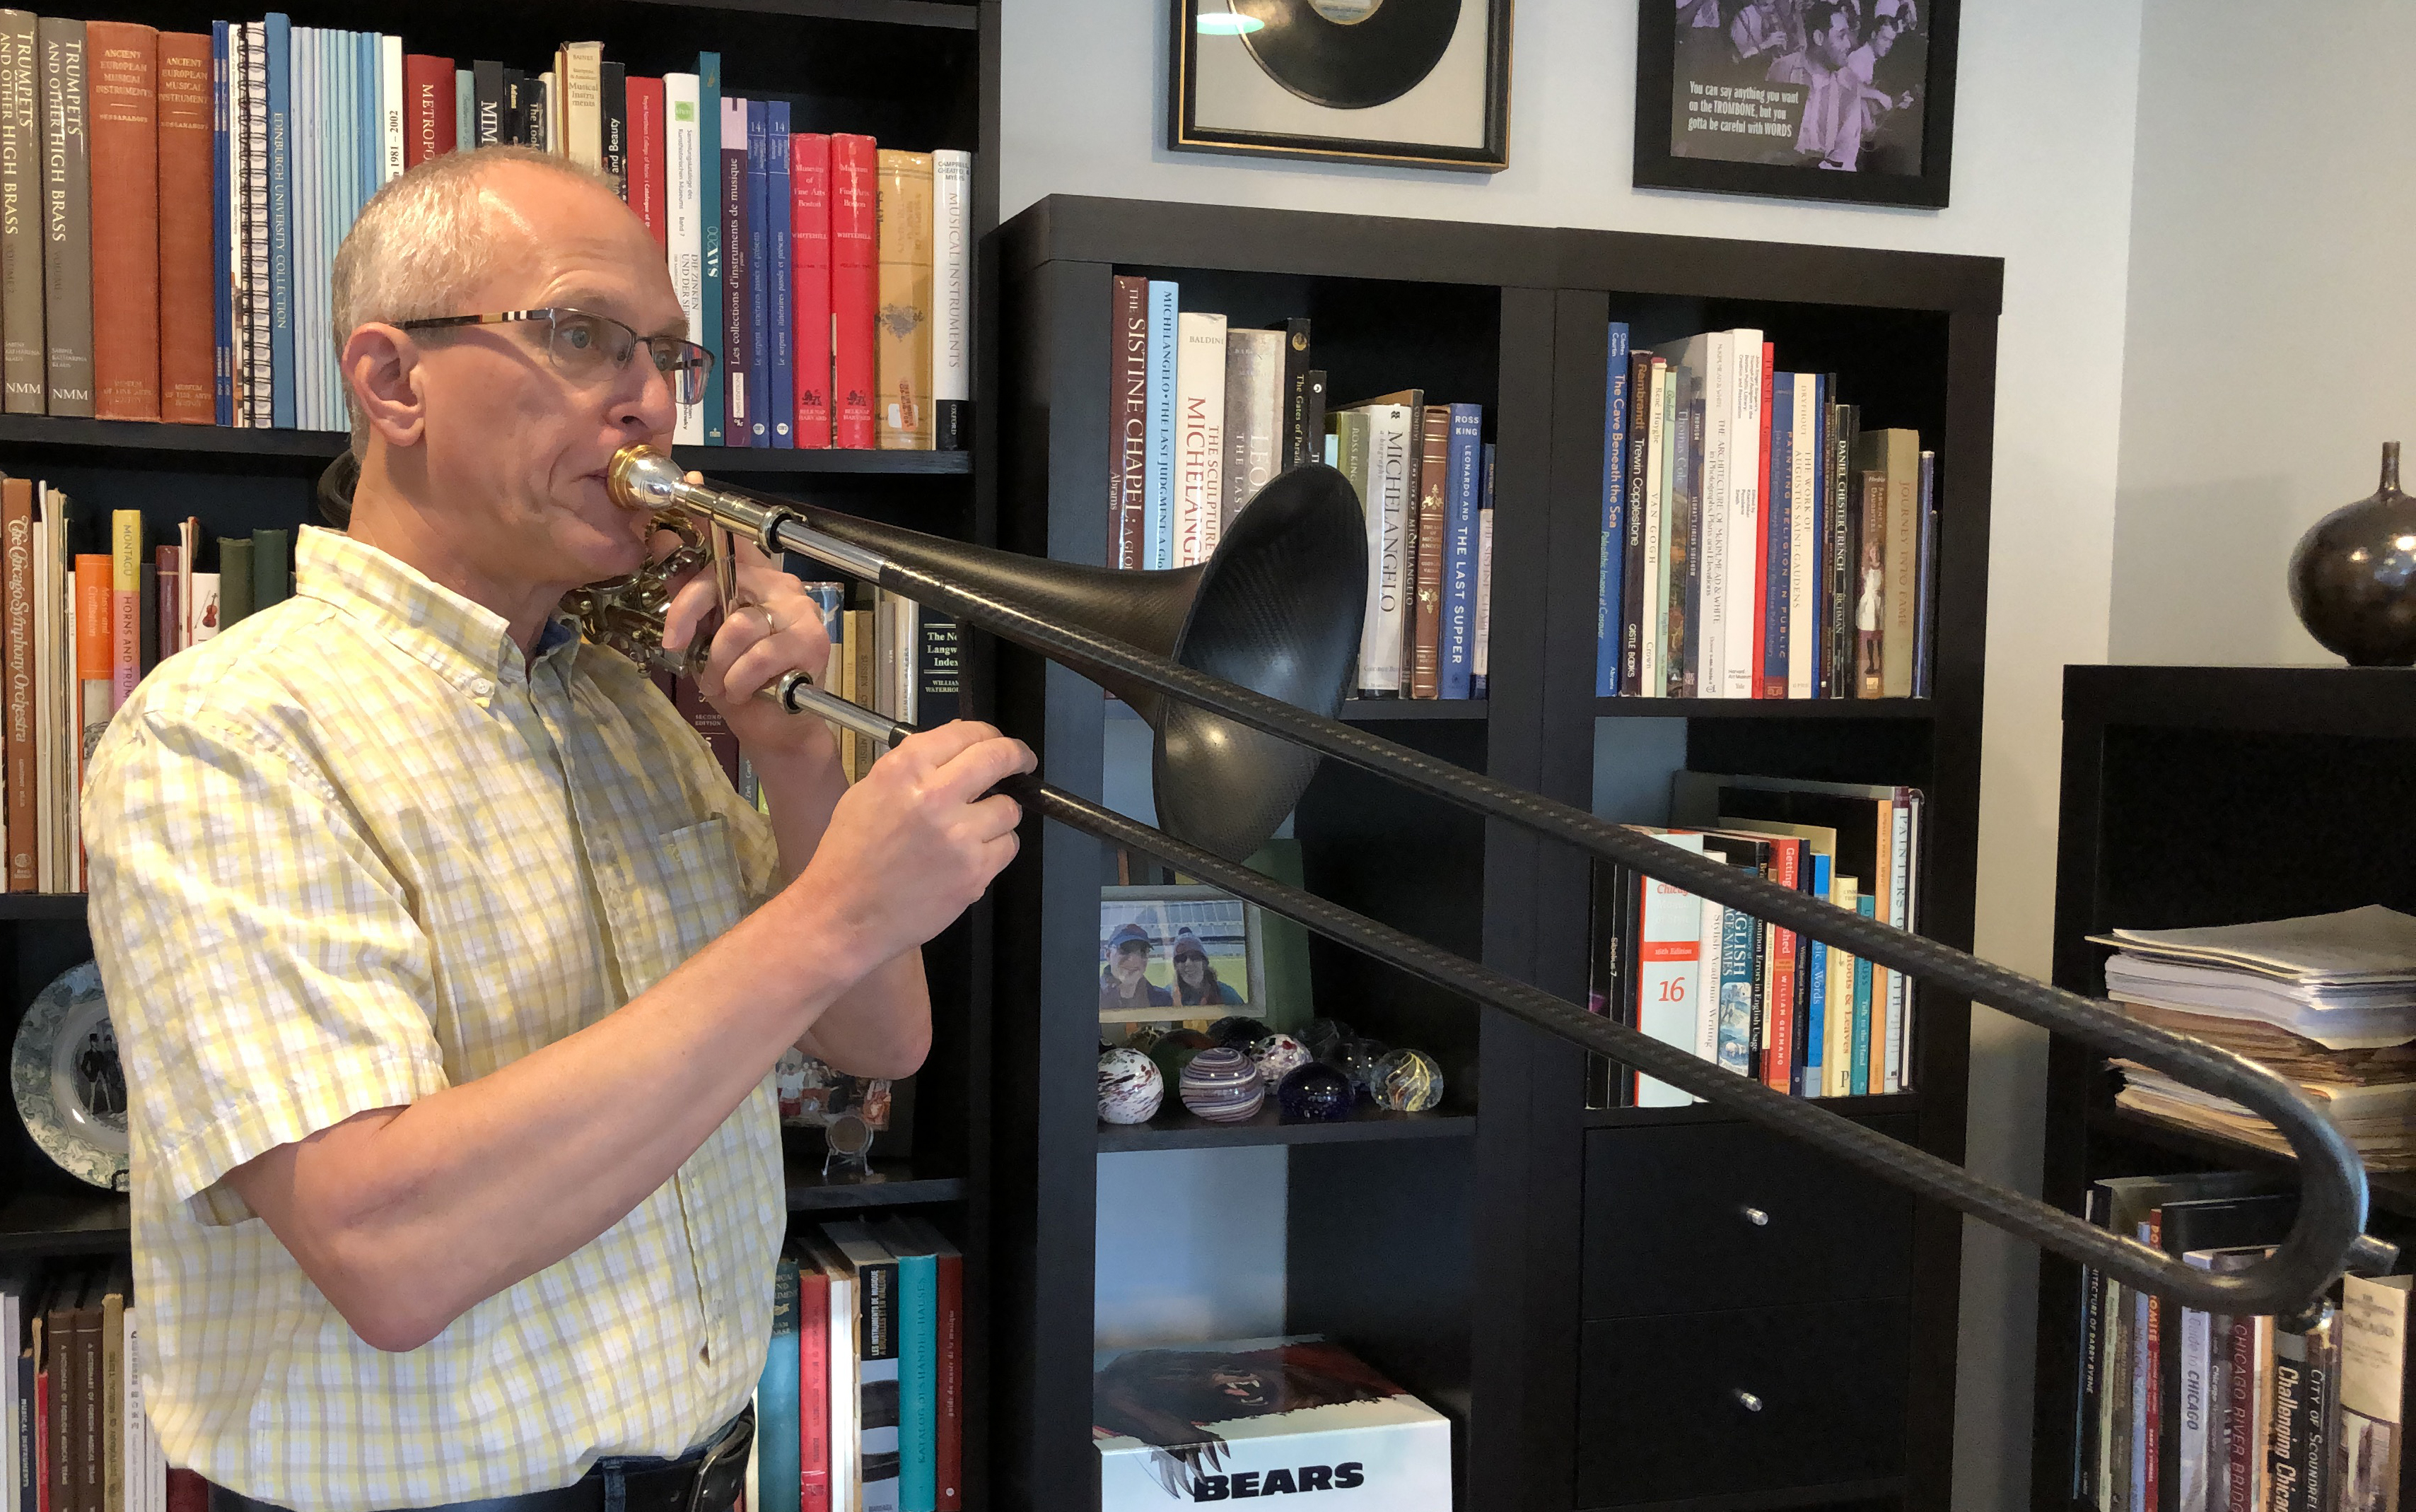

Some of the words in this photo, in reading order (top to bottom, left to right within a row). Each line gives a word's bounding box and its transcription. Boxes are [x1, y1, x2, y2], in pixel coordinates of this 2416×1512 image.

[0, 33, 11, 65] AND
[49, 40, 59, 74] AND
[100, 61, 148, 72] EUROPEAN
[104, 49, 142, 59] ANCIENT
[166, 57, 203, 68] ANCIENT
[18, 33, 33, 128] TRUMPETS
[66, 40, 81, 136] TRUMPETS
[103, 73, 141, 84] MUSICAL
[161, 69, 209, 81] EUROPEAN
[568, 81, 599, 93] Musical
[1690, 81, 1703, 95] You
[1705, 83, 1718, 98] can
[1720, 86, 1732, 100] say
[1734, 86, 1766, 104] anything
[1766, 90, 1780, 103] you
[1781, 91, 1799, 104] want
[1, 71, 13, 120] OTHER
[49, 78, 62, 128] OTHER
[530, 102, 539, 122] The
[571, 90, 595, 100] Instru
[571, 99, 596, 108] ments
[1688, 102, 1698, 112] on
[1700, 100, 1712, 114] the
[1713, 100, 1758, 118] TROMBONE,
[1759, 106, 1771, 119] but
[1773, 109, 1787, 122] you
[388, 110, 399, 134] 2002
[481, 100, 498, 145] MIM
[609, 117, 621, 152] Beauty
[751, 122, 761, 132] 14
[774, 121, 785, 132] 14
[1688, 117, 1708, 131] gotta
[1709, 118, 1719, 130] be
[1720, 119, 1746, 133] careful
[1747, 121, 1763, 135] with
[1763, 122, 1793, 138] WORDS
[2, 125, 17, 175] HIGH
[50, 133, 65, 182] HIGH
[274, 112, 284, 183] EDINBURGH
[390, 146, 399, 168] 1981
[612, 156, 620, 174] and
[4, 182, 18, 235] BRASS
[51, 190, 66, 242] BRASS
[274, 184, 286, 252] UNIVERSITY
[798, 199, 822, 208] Boston
[949, 192, 960, 255] MUSICAL
[275, 254, 286, 329] COLLECTION
[691, 272, 699, 310] ZINKEN
[1129, 287, 1139, 314] THE
[949, 263, 960, 368] INSTRUMENTS
[1127, 317, 1145, 413] SISTINE
[6, 382, 41, 394] NMM
[52, 388, 88, 401] NMM
[1297, 374, 1305, 393] The
[1614, 373, 1626, 396] The
[1635, 363, 1647, 430] Rembrandt
[1295, 396, 1304, 421] Gates
[1454, 416, 1480, 424] ROSS
[1613, 397, 1625, 431] Cave
[1208, 425, 1220, 456] THE
[1295, 424, 1303, 436] of
[1455, 427, 1478, 436] KING
[1651, 411, 1662, 445] Huyghe
[1677, 408, 1688, 455] Thomas
[1124, 418, 1144, 523] CHAPEL:
[1463, 445, 1472, 498] LEONARDO
[1611, 432, 1623, 483] Beneath
[1633, 438, 1645, 475] Trewin
[1676, 456, 1688, 484] Cole
[1785, 430, 1794, 500] PAINTING
[1838, 440, 1847, 479] DANIEL
[1109, 471, 1121, 511] Abrams
[1610, 482, 1622, 503] the
[1717, 440, 1725, 510] ARCHITECTURE
[1794, 450, 1802, 511] AUGUSTUS
[1204, 459, 1218, 551] SCULPTURE
[1380, 430, 1404, 613] MICHELANGELO
[1609, 505, 1621, 529] Sea
[1630, 477, 1644, 547] Copplestone
[1650, 493, 1659, 517] VAN
[1837, 481, 1846, 527] CHESTER
[8, 515, 30, 546] The
[1457, 527, 1468, 556] THE
[1781, 507, 1791, 577] RELIGION
[1803, 516, 1811, 533] OF
[123, 524, 133, 577] MONTAGU
[1649, 524, 1657, 564] GOGH
[1793, 513, 1802, 609] SAINT-GAUDENS
[1836, 529, 1845, 572] FRENCH
[8, 546, 28, 600] Chicago
[1454, 561, 1466, 599] LAST
[1712, 595, 1721, 624] WHITE
[1780, 584, 1788, 599] IN
[123, 596, 133, 635] HORNS
[1778, 606, 1787, 659] PUBLIC
[9, 599, 30, 674] Symphony
[123, 638, 133, 664] AND
[927, 632, 945, 641] The
[1452, 605, 1464, 664] SUPPER
[1627, 623, 1638, 649] CASTLE
[860, 654, 868, 687] SUSSEX
[1627, 650, 1635, 679] BOOKS
[1645, 641, 1655, 669] Crown
[11, 670, 30, 742] Orchestra
[860, 738, 868, 765] MUSIC
[1782, 847, 1795, 888] Getting
[1896, 814, 1908, 909] PAINTERS
[1712, 913, 1722, 951] Stylish
[1709, 954, 1720, 1005] Academic
[1753, 953, 1763, 983] Errors
[1658, 976, 1686, 1003] 16
[1753, 982, 1761, 991] in
[1779, 975, 1788, 1016] WILLIAM
[1813, 968, 1825, 1005] Words
[1751, 990, 1762, 1026] English
[1705, 1008, 1717, 1049] Writing
[1750, 1026, 1758, 1053] Usage
[1777, 1019, 1786, 1066] GERMANO
[870, 1296, 878, 1305] DE
[2087, 1332, 2096, 1364] BARRY
[2233, 1323, 2248, 1400] CHICAGO
[2275, 1365, 2299, 1460] Challenging
[2232, 1407, 2246, 1457] RIVER
[1194, 1460, 1365, 1503] BEARS
